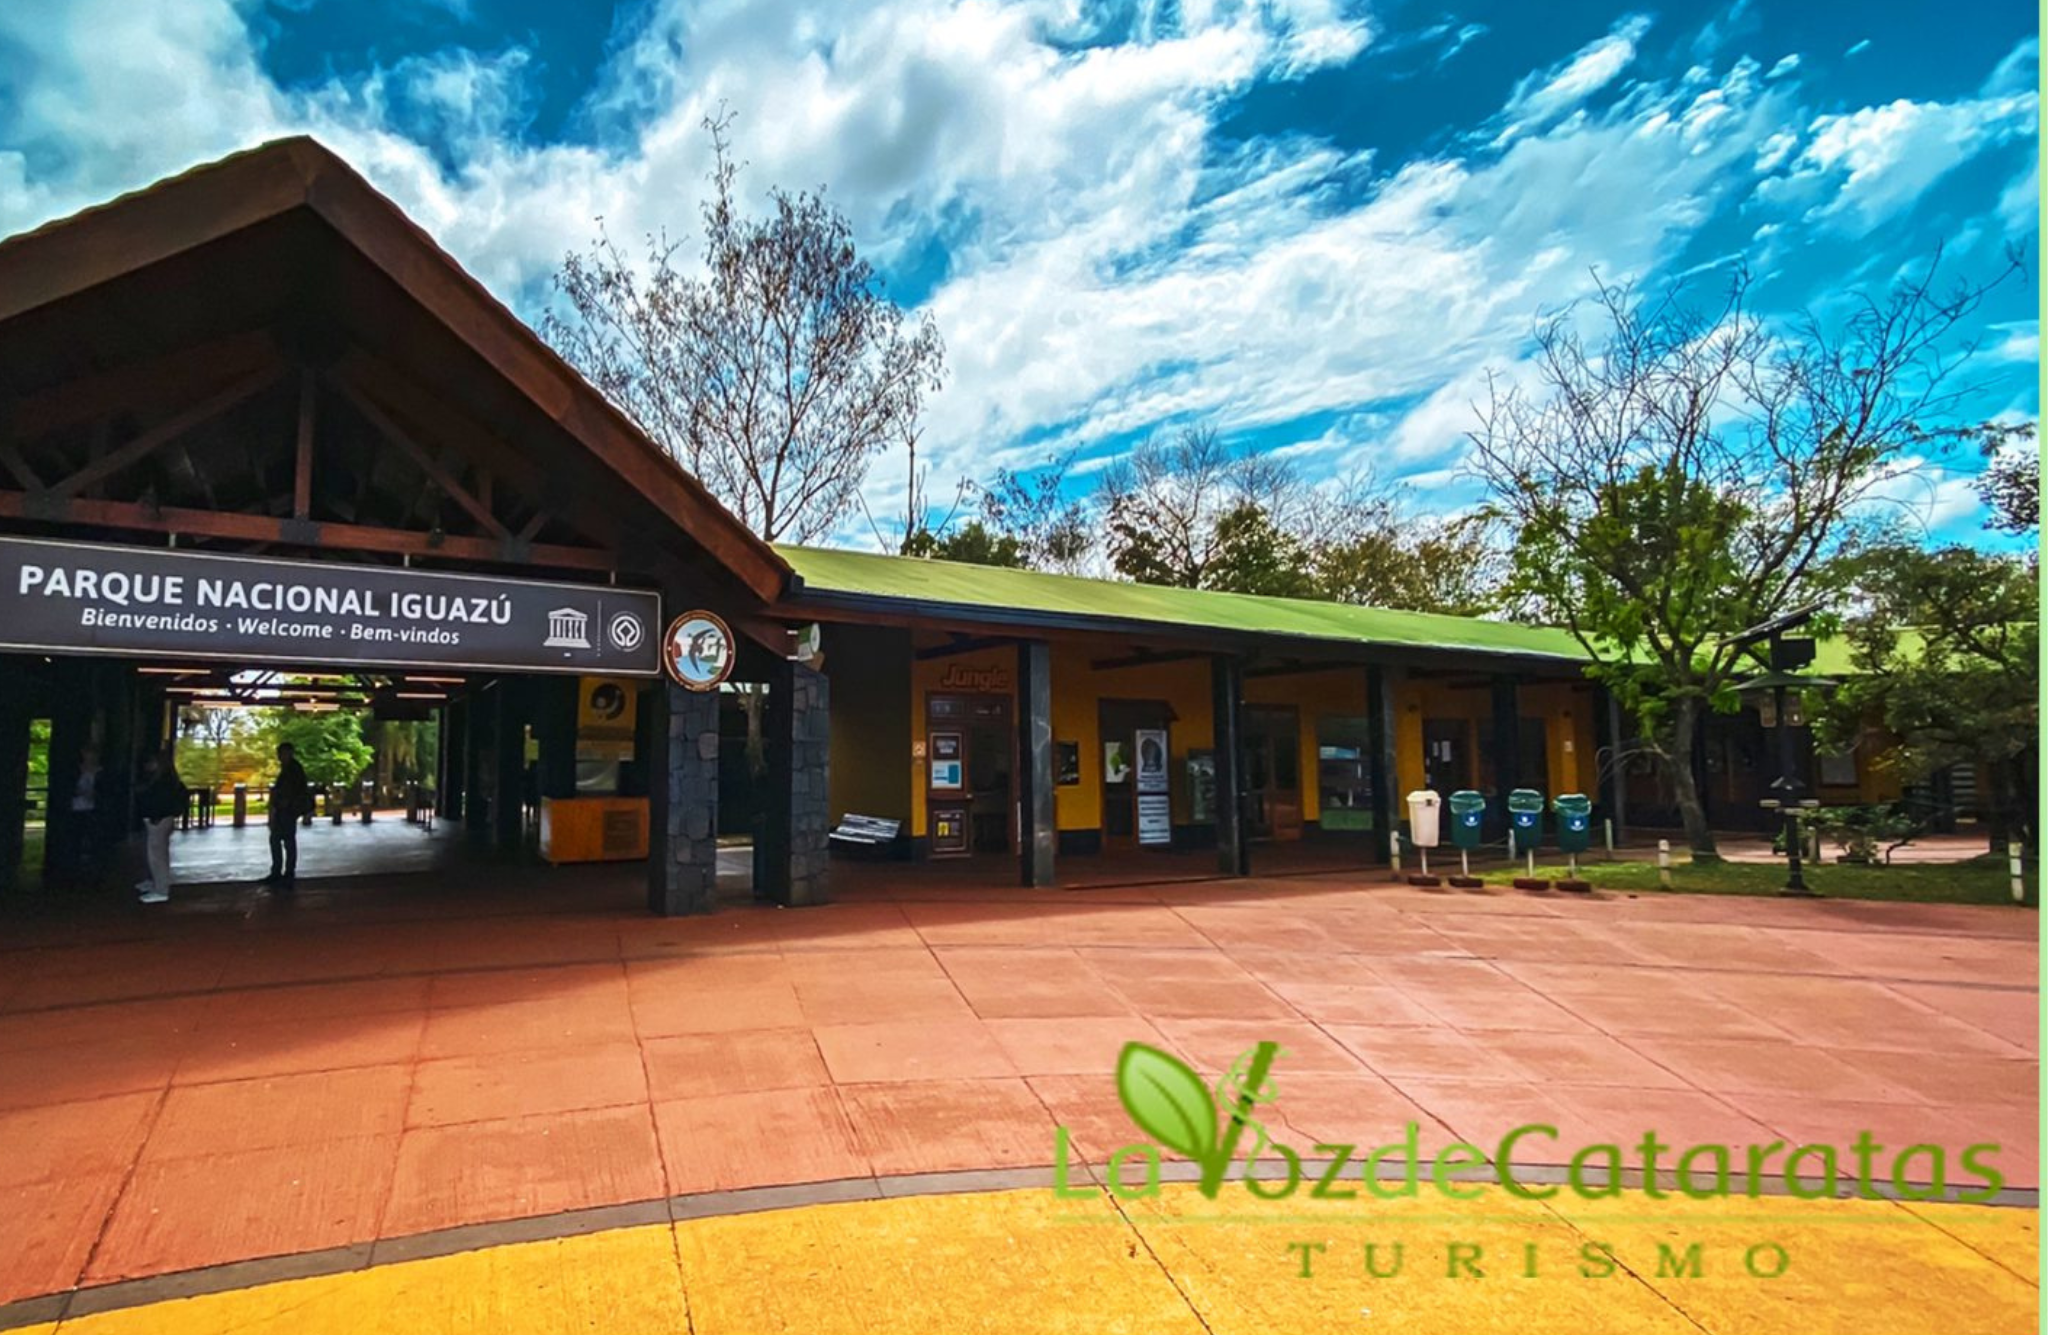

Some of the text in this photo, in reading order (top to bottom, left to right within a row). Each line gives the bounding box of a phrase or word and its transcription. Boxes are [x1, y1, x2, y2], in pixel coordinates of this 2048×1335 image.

[19, 564, 512, 624] PARQUE NACIONAL IGUAZÚ
[81, 607, 460, 645] Bienvenidos Welcome Bem-vindos
[942, 664, 1007, 692] Jungle
